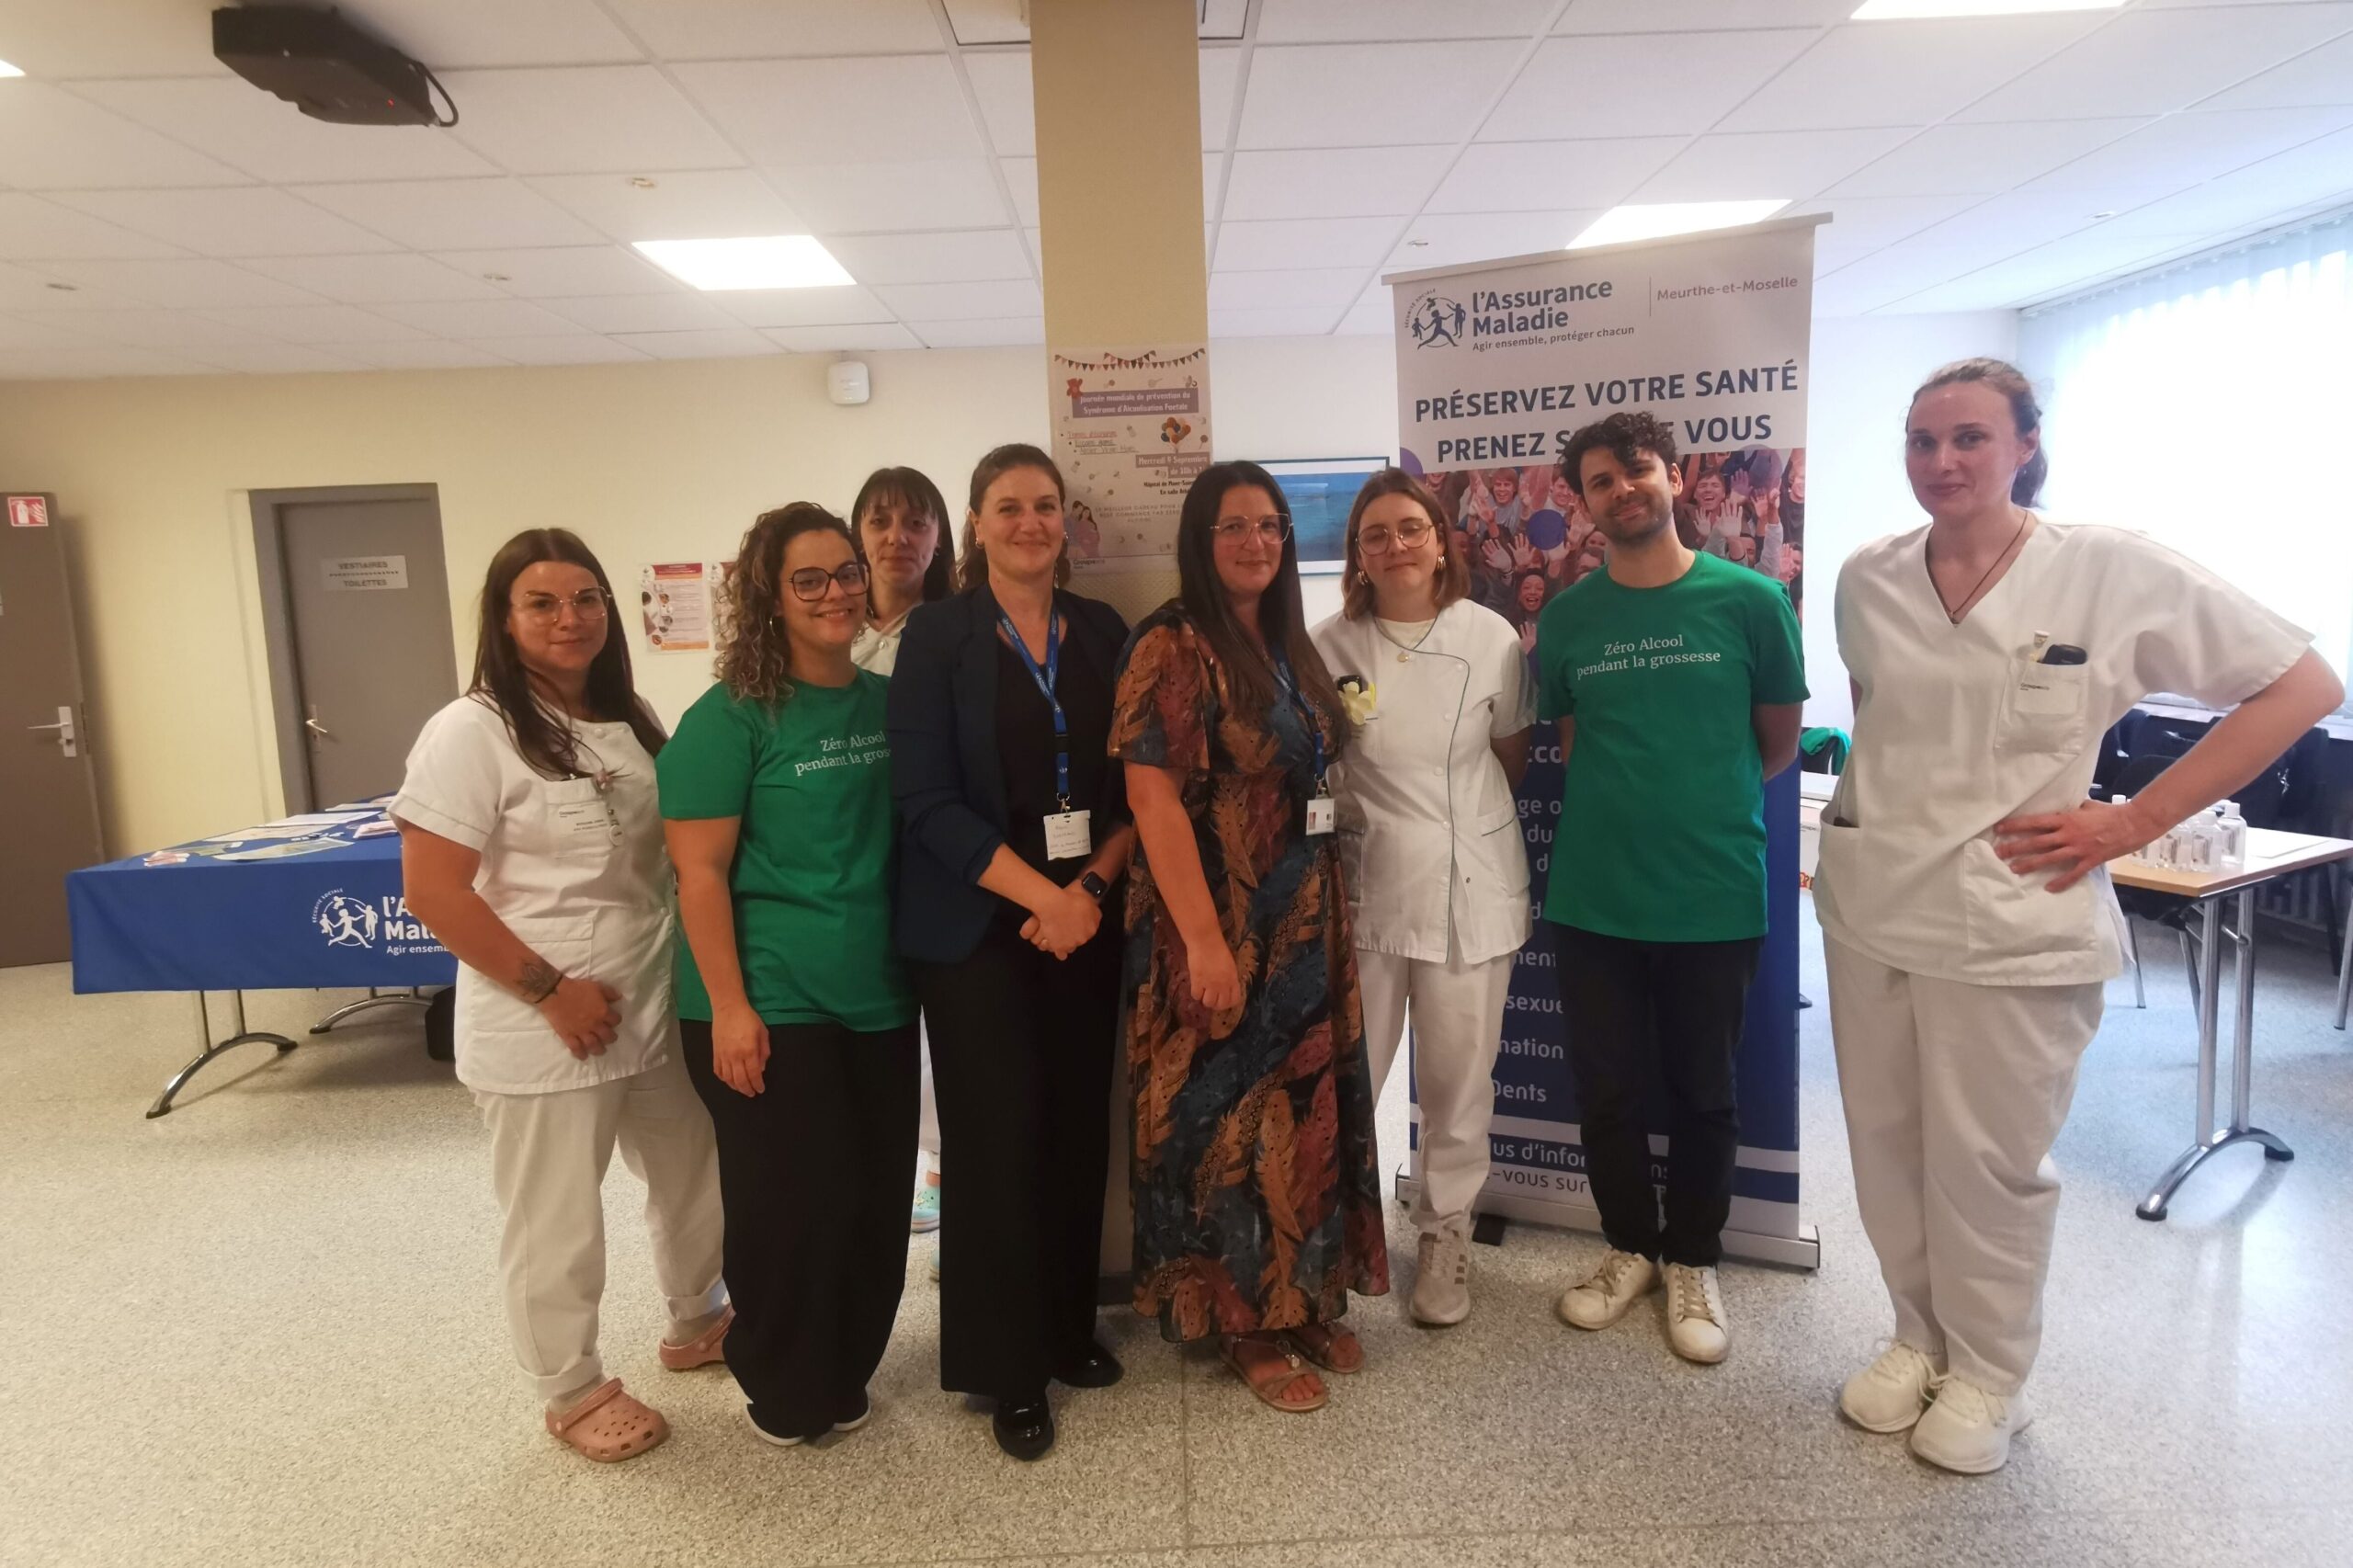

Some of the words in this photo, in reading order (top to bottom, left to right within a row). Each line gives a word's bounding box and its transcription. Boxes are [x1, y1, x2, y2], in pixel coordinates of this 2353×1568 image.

[1472, 280, 1612, 313] l'Assurance
[1656, 277, 1798, 301] Meurthe-et-Moselle
[1472, 307, 1569, 337] Maladie
[1472, 341, 1493, 353] Agir
[1495, 335, 1548, 349] ensemble,
[1550, 329, 1595, 345] protéger
[1597, 326, 1634, 338] chacun
[1415, 384, 1576, 423] PRÉSERVEZ
[1585, 373, 1685, 406] VOTRE
[1695, 358, 1798, 397] SANTÉ
[1438, 432, 1546, 463] PRENEZ
[1684, 414, 1772, 444] VOUS
[343, 579, 388, 587] TOILETTES
[1604, 641, 1635, 656] Zéro
[1640, 633, 1684, 652] Alcool
[1576, 656, 1629, 681] pendant
[1632, 654, 1645, 668] la
[1650, 651, 1721, 670] grossesse
[820, 737, 848, 752] Zéro
[850, 730, 887, 749] Alcool
[794, 756, 848, 777] pendant
[848, 752, 862, 765] la
[863, 747, 892, 765] gros
[386, 945, 407, 956] Agir
[409, 945, 449, 953] ensem
[1499, 1038, 1563, 1060] nation
[1556, 1177, 1587, 1193] sur
